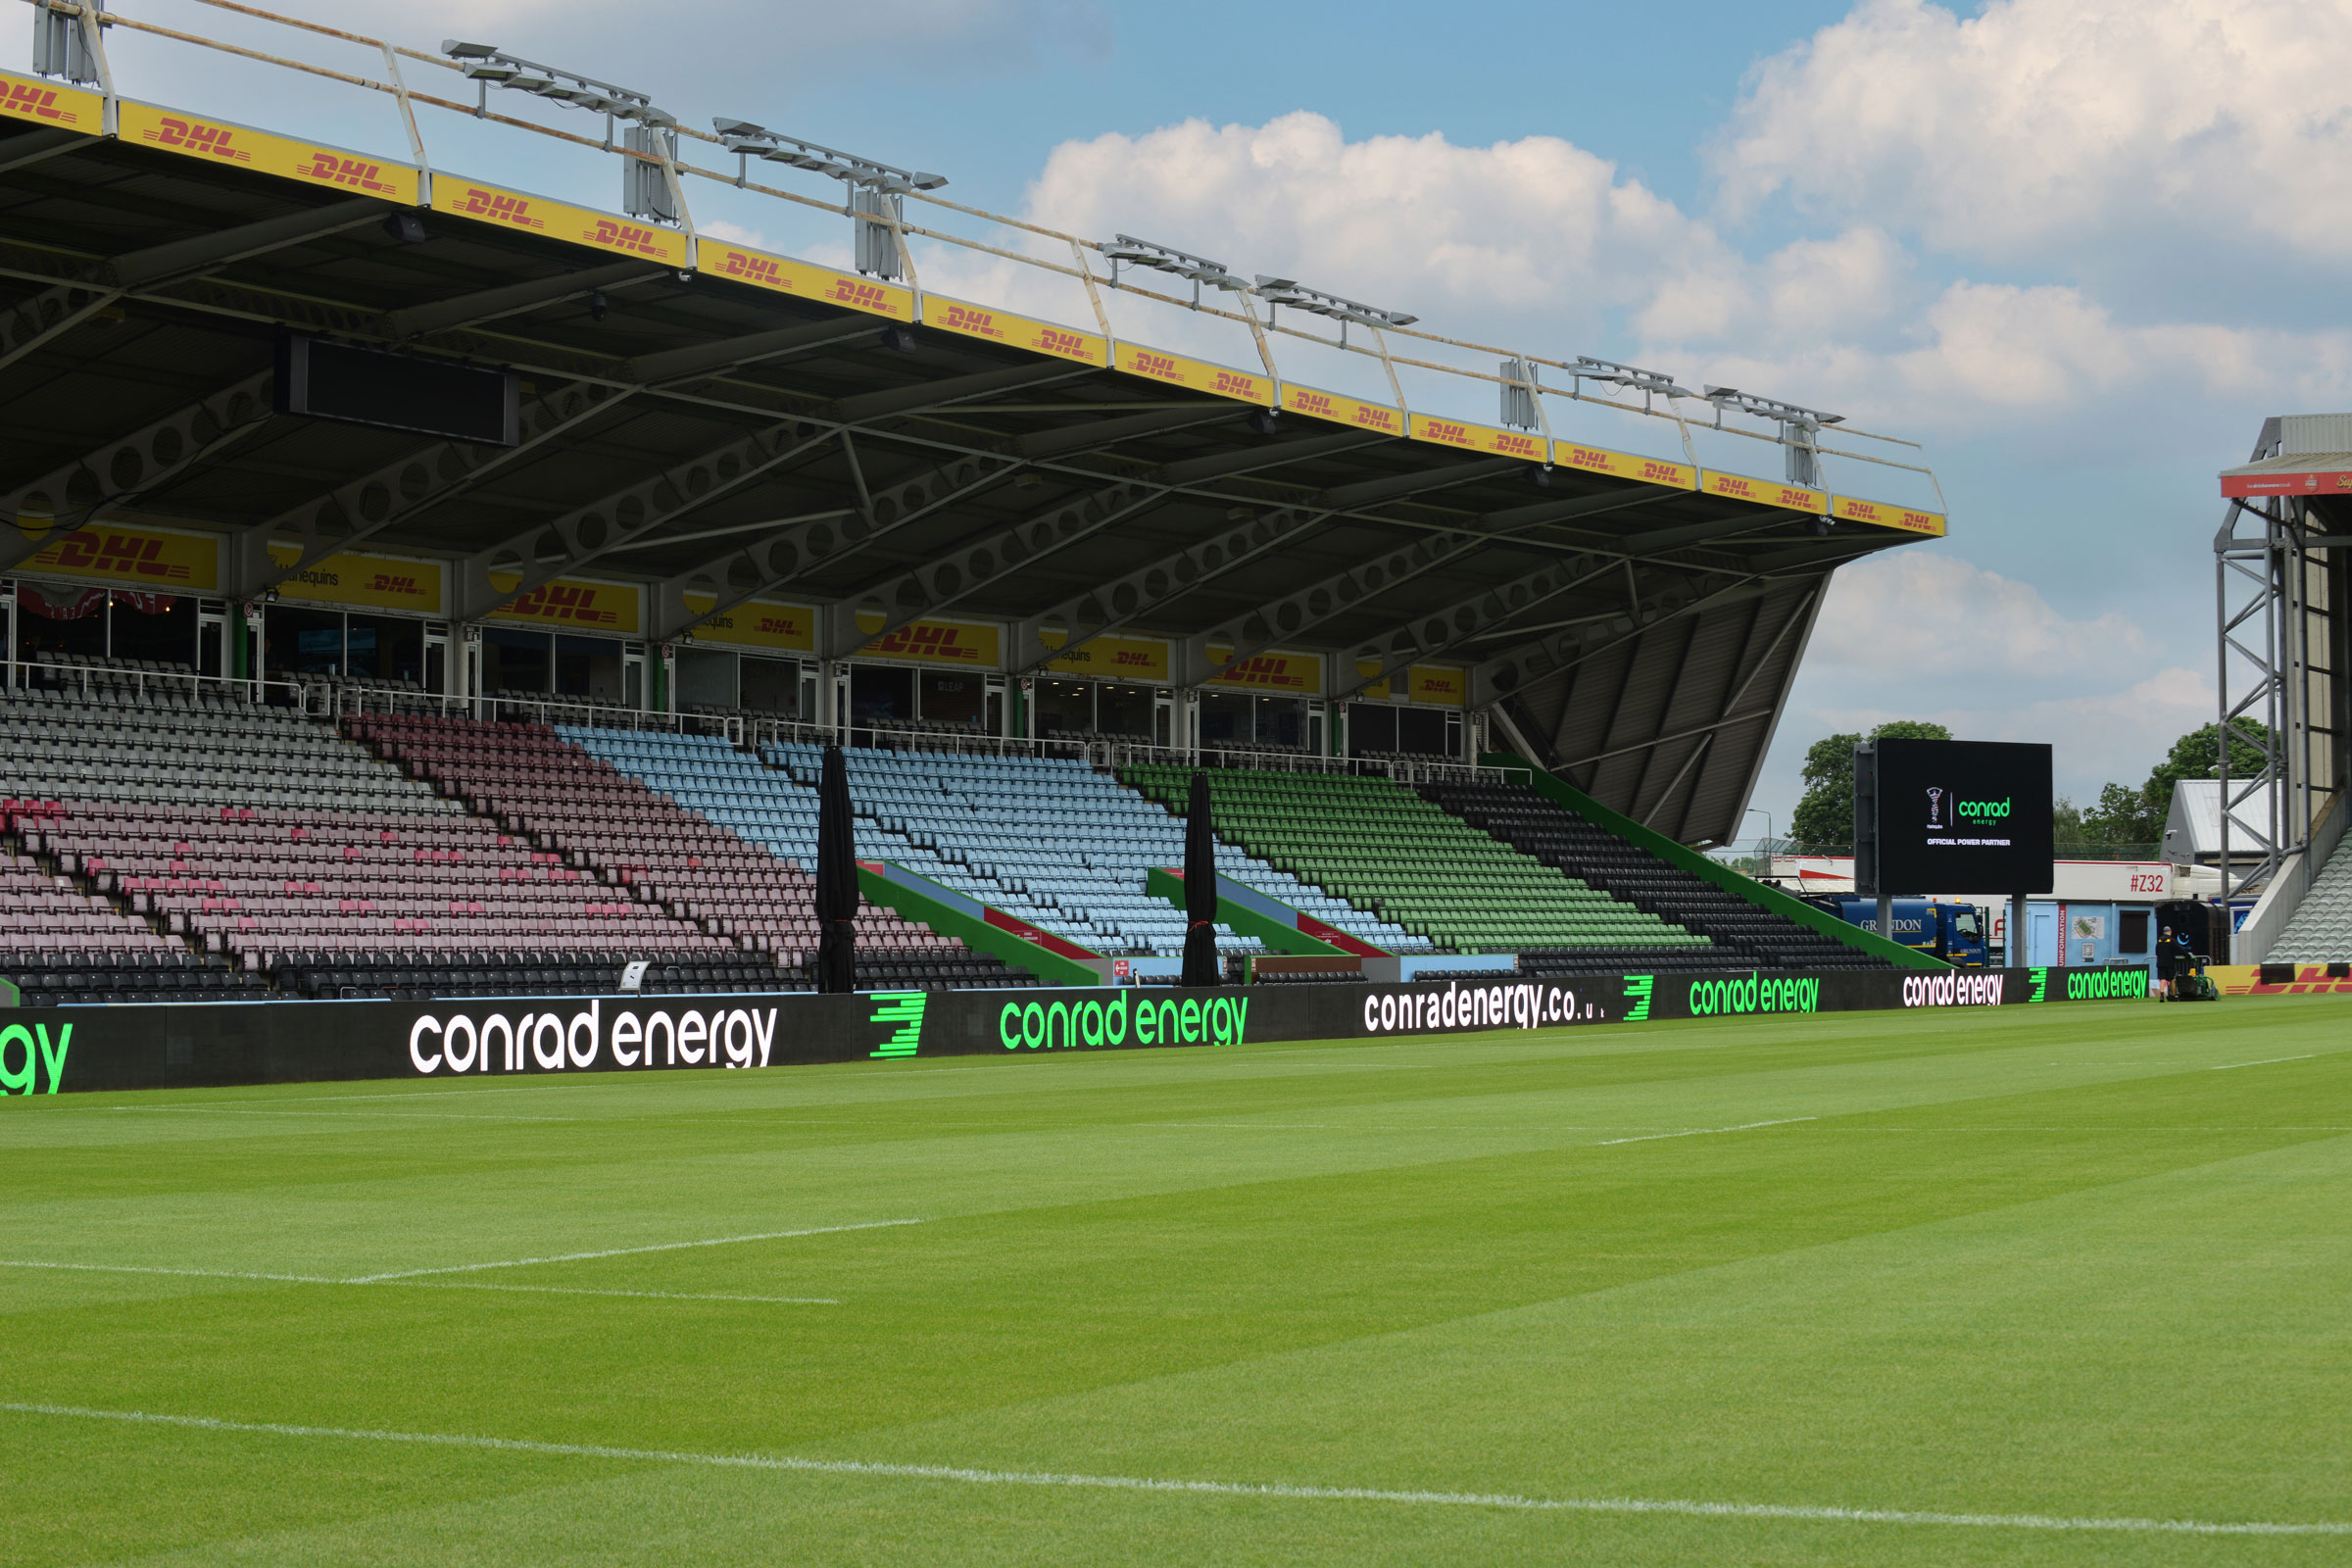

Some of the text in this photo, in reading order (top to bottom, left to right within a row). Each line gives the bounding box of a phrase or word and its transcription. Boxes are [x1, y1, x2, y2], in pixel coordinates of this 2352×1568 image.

[158, 117, 236, 158] DHL
[311, 153, 383, 191] DHL
[465, 188, 532, 225] DHL
[595, 219, 657, 255] DHL
[725, 252, 782, 285] DHL
[835, 279, 888, 311] DHL
[947, 306, 995, 335] DHL
[1040, 328, 1086, 358] DHL
[1136, 352, 1177, 379] DHL
[1216, 372, 1254, 398] DHL
[1296, 391, 1333, 416] DHL
[1357, 406, 1392, 429] DHL
[1426, 420, 1468, 444] DHL
[1495, 434, 1536, 456] DHL
[1572, 448, 1609, 470] DHL
[1643, 462, 1679, 483] DHL
[1718, 477, 1751, 497] DHL
[1781, 489, 1812, 509] DHL
[1847, 501, 1877, 520] DHL
[1903, 512, 1932, 531] DHL
[56, 531, 170, 576] DHL
[371, 573, 418, 595] DHL
[513, 582, 602, 622] DHL
[760, 617, 796, 635] DHL
[879, 625, 963, 658] DHL
[1116, 651, 1151, 667] DHL
[1224, 655, 1292, 685] DHL
[1423, 678, 1452, 693] DHL
[1959, 797, 2010, 817] conrad
[2131, 874, 2164, 893] #Z32
[1860, 918, 1922, 931] GRNDON
[1690, 971, 1820, 1015] conrad energy
[1903, 968, 2005, 1007] conrad energy
[2068, 966, 2148, 1000] conrad energy
[1001, 990, 1249, 1050] conrad energy
[411, 999, 779, 1075] conrad energy
